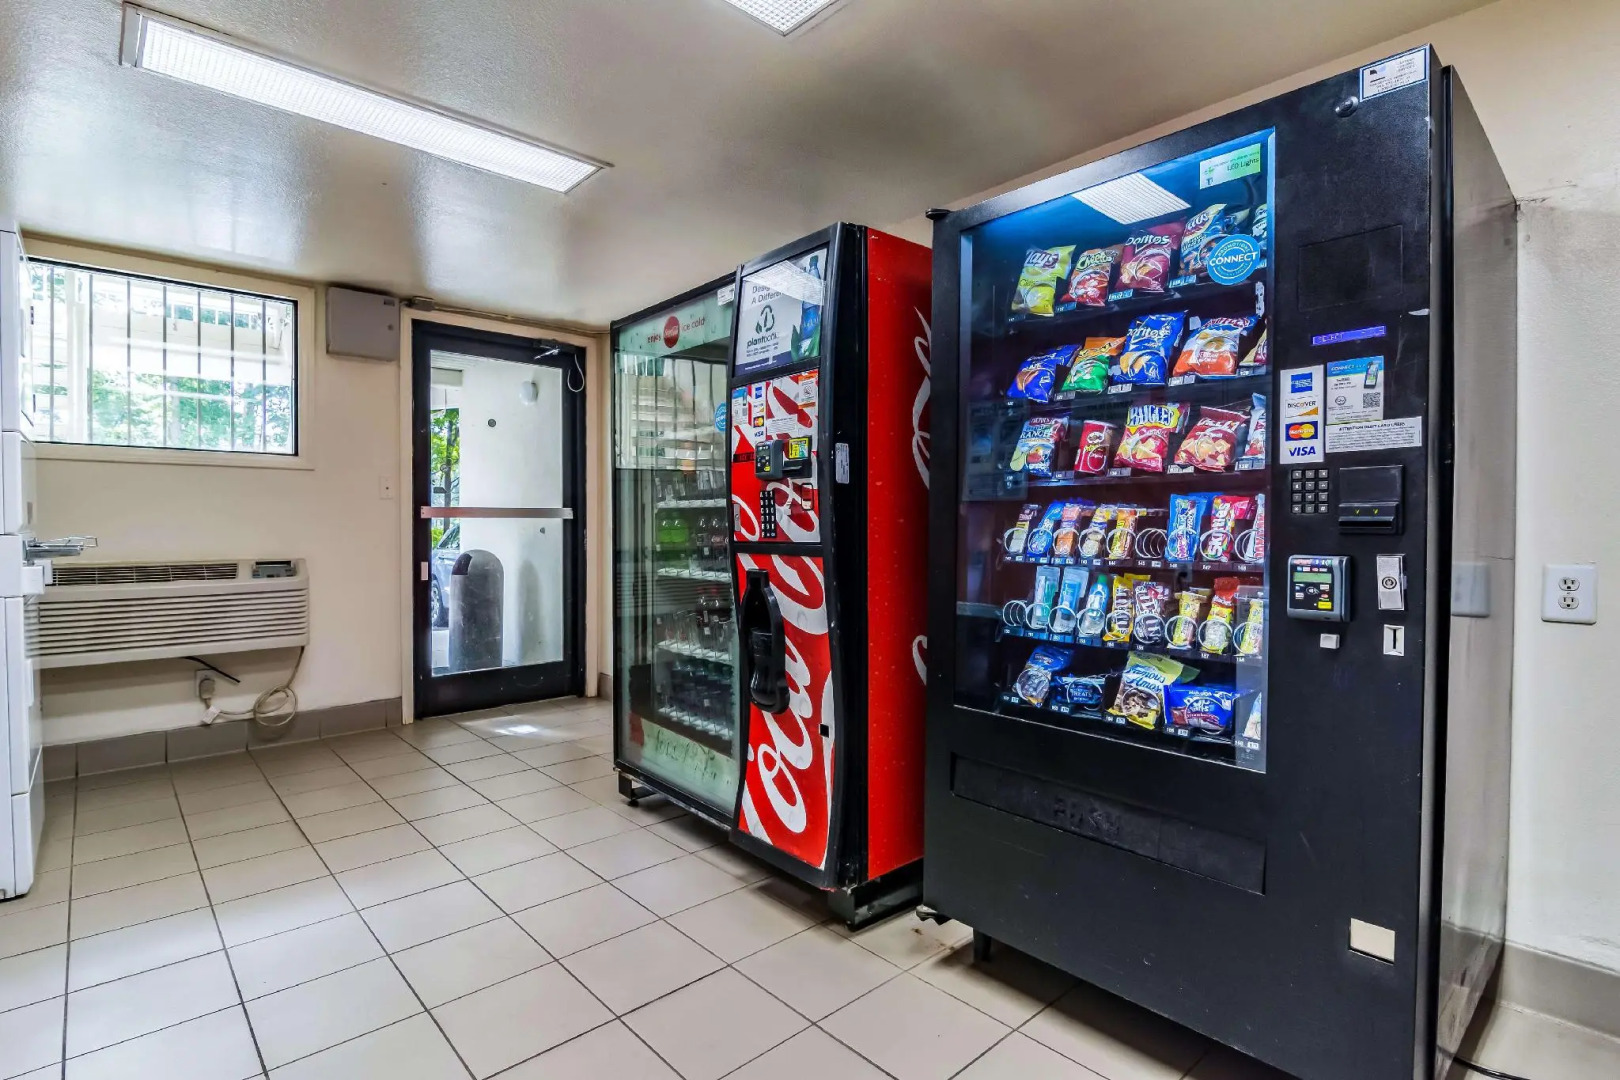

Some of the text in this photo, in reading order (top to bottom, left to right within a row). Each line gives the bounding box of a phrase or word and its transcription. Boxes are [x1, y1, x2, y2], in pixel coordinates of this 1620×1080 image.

[1240, 157, 1259, 169] Lights
[1125, 235, 1171, 247] Doritos
[1209, 251, 1258, 267] CONNECT
[691, 317, 706, 330] cold
[1127, 324, 1171, 340] Doritos
[1287, 400, 1316, 409] DISCOVER
[1129, 404, 1174, 426] BUGLES
[1289, 446, 1316, 457] VISA
[1209, 502, 1231, 556] Skittles
[1124, 663, 1166, 684] Famous
[1126, 675, 1162, 693] Amos
